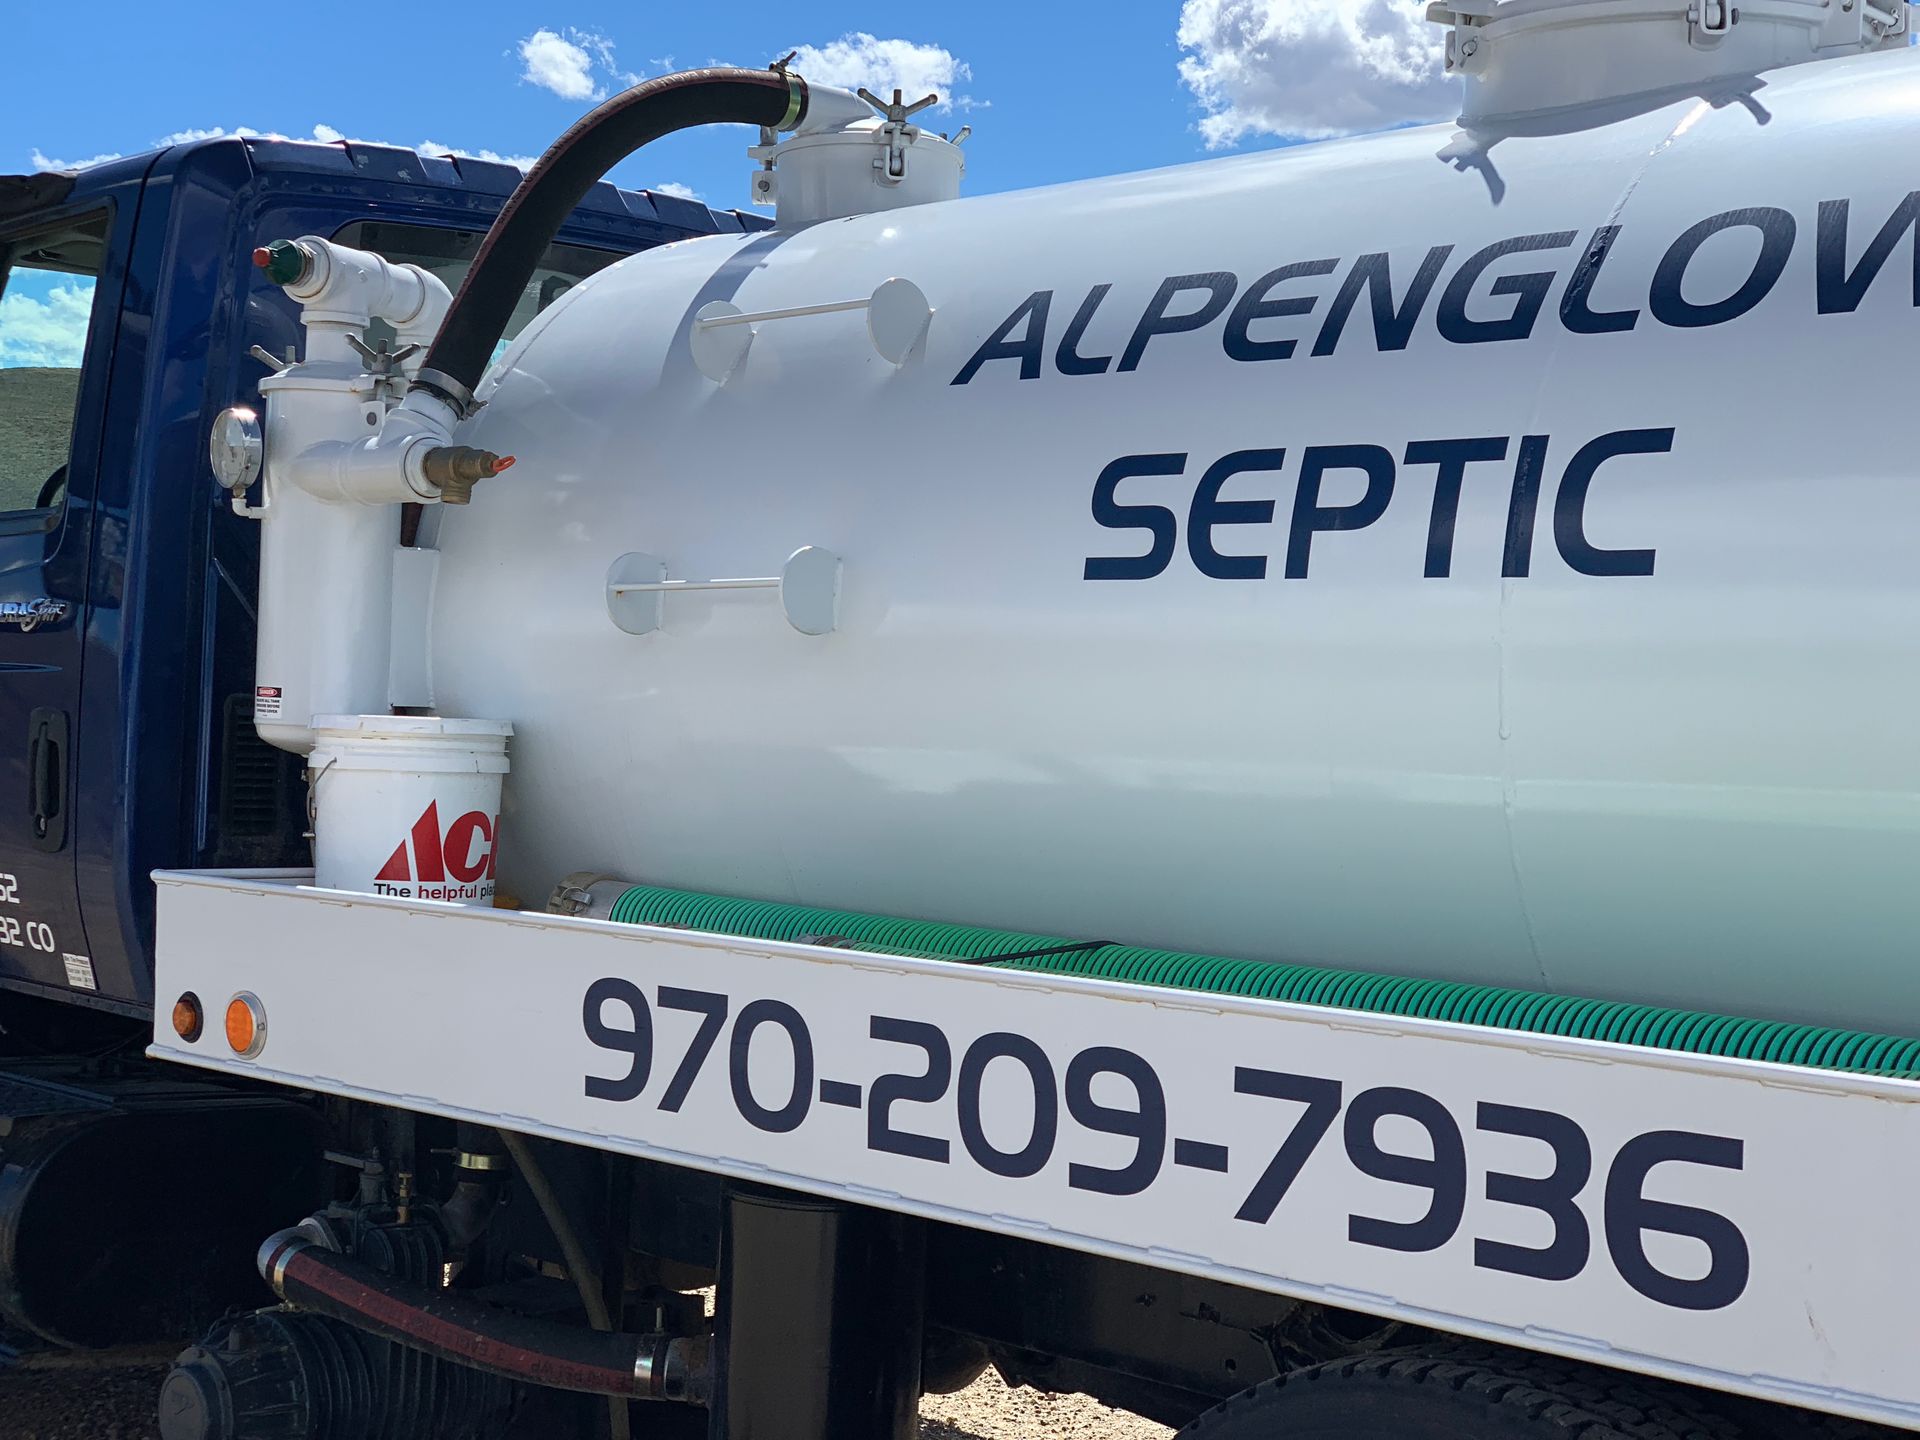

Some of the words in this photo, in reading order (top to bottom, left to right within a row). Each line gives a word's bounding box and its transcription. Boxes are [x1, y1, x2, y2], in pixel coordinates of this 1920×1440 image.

[1083, 427, 1676, 581] SEPTIC
[26, 921, 55, 952] CO
[373, 883, 411, 897] The
[418, 885, 477, 902] helpful
[582, 977, 1750, 1311] 970-209-7936
